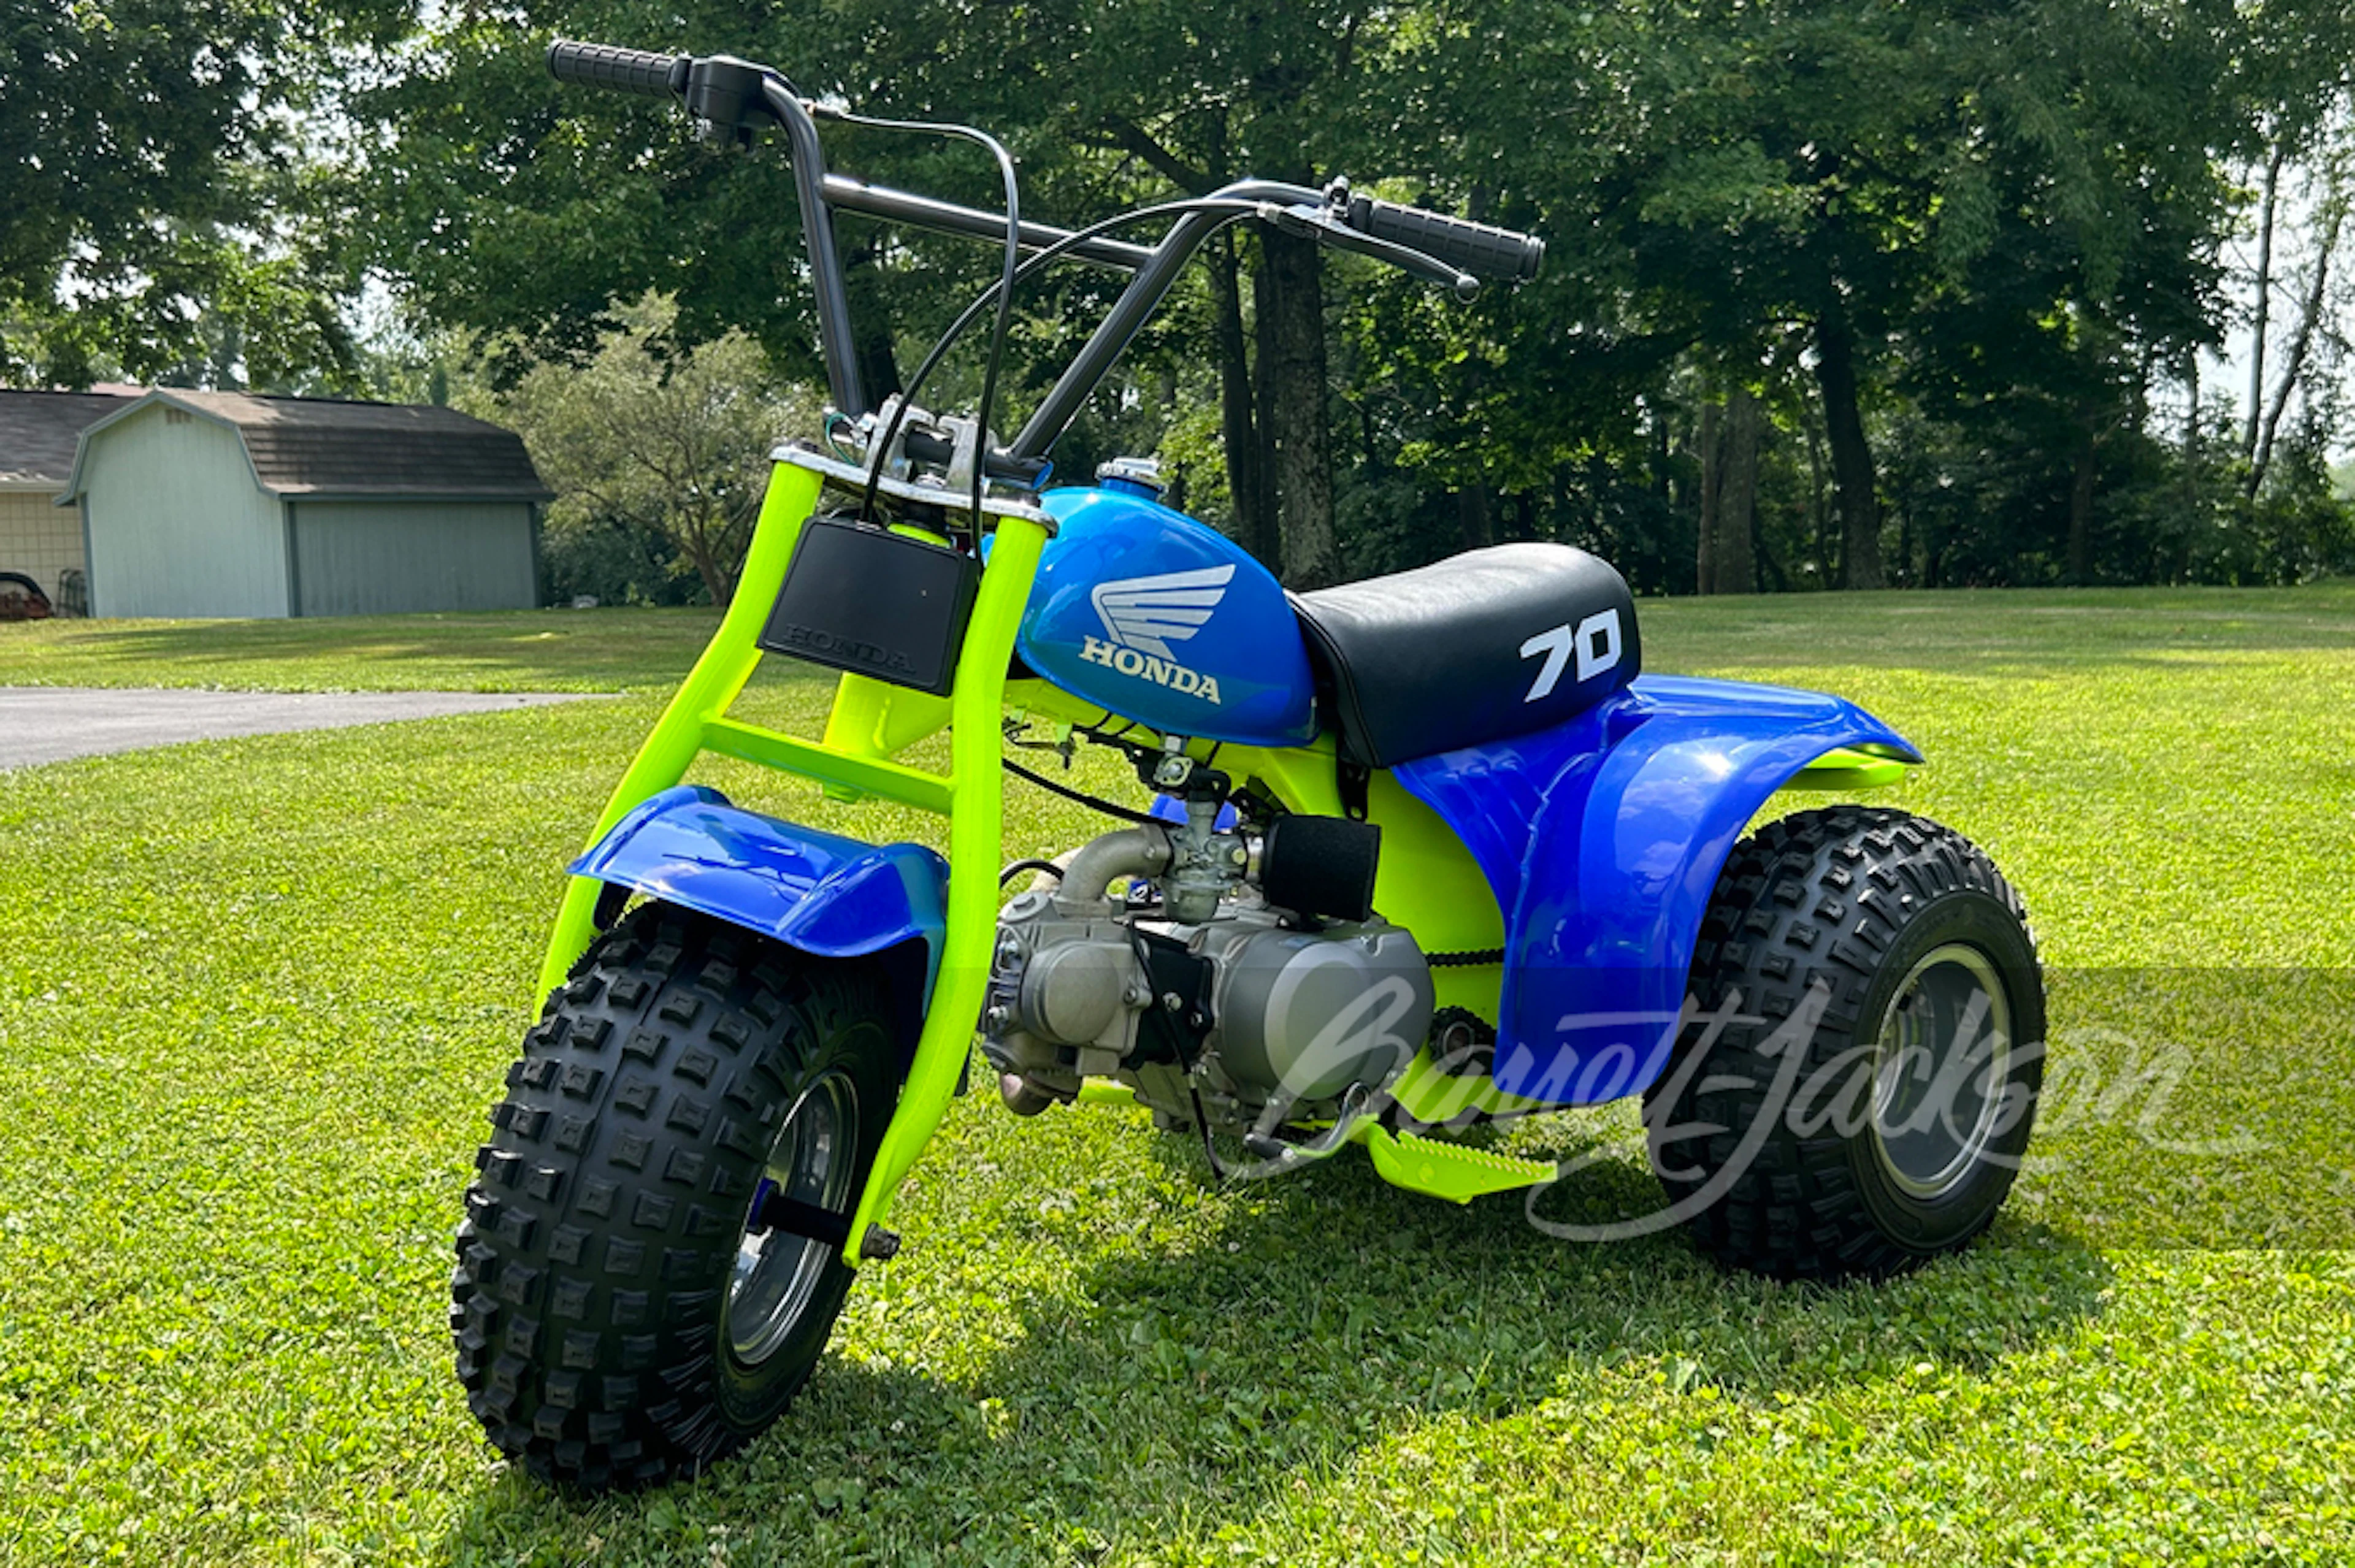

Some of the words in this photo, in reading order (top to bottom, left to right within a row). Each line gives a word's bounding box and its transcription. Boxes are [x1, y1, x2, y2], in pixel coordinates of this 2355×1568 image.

[783, 622, 917, 675] HONDA
[1078, 635, 1222, 705] HONDA
[1519, 608, 1622, 703] 70
